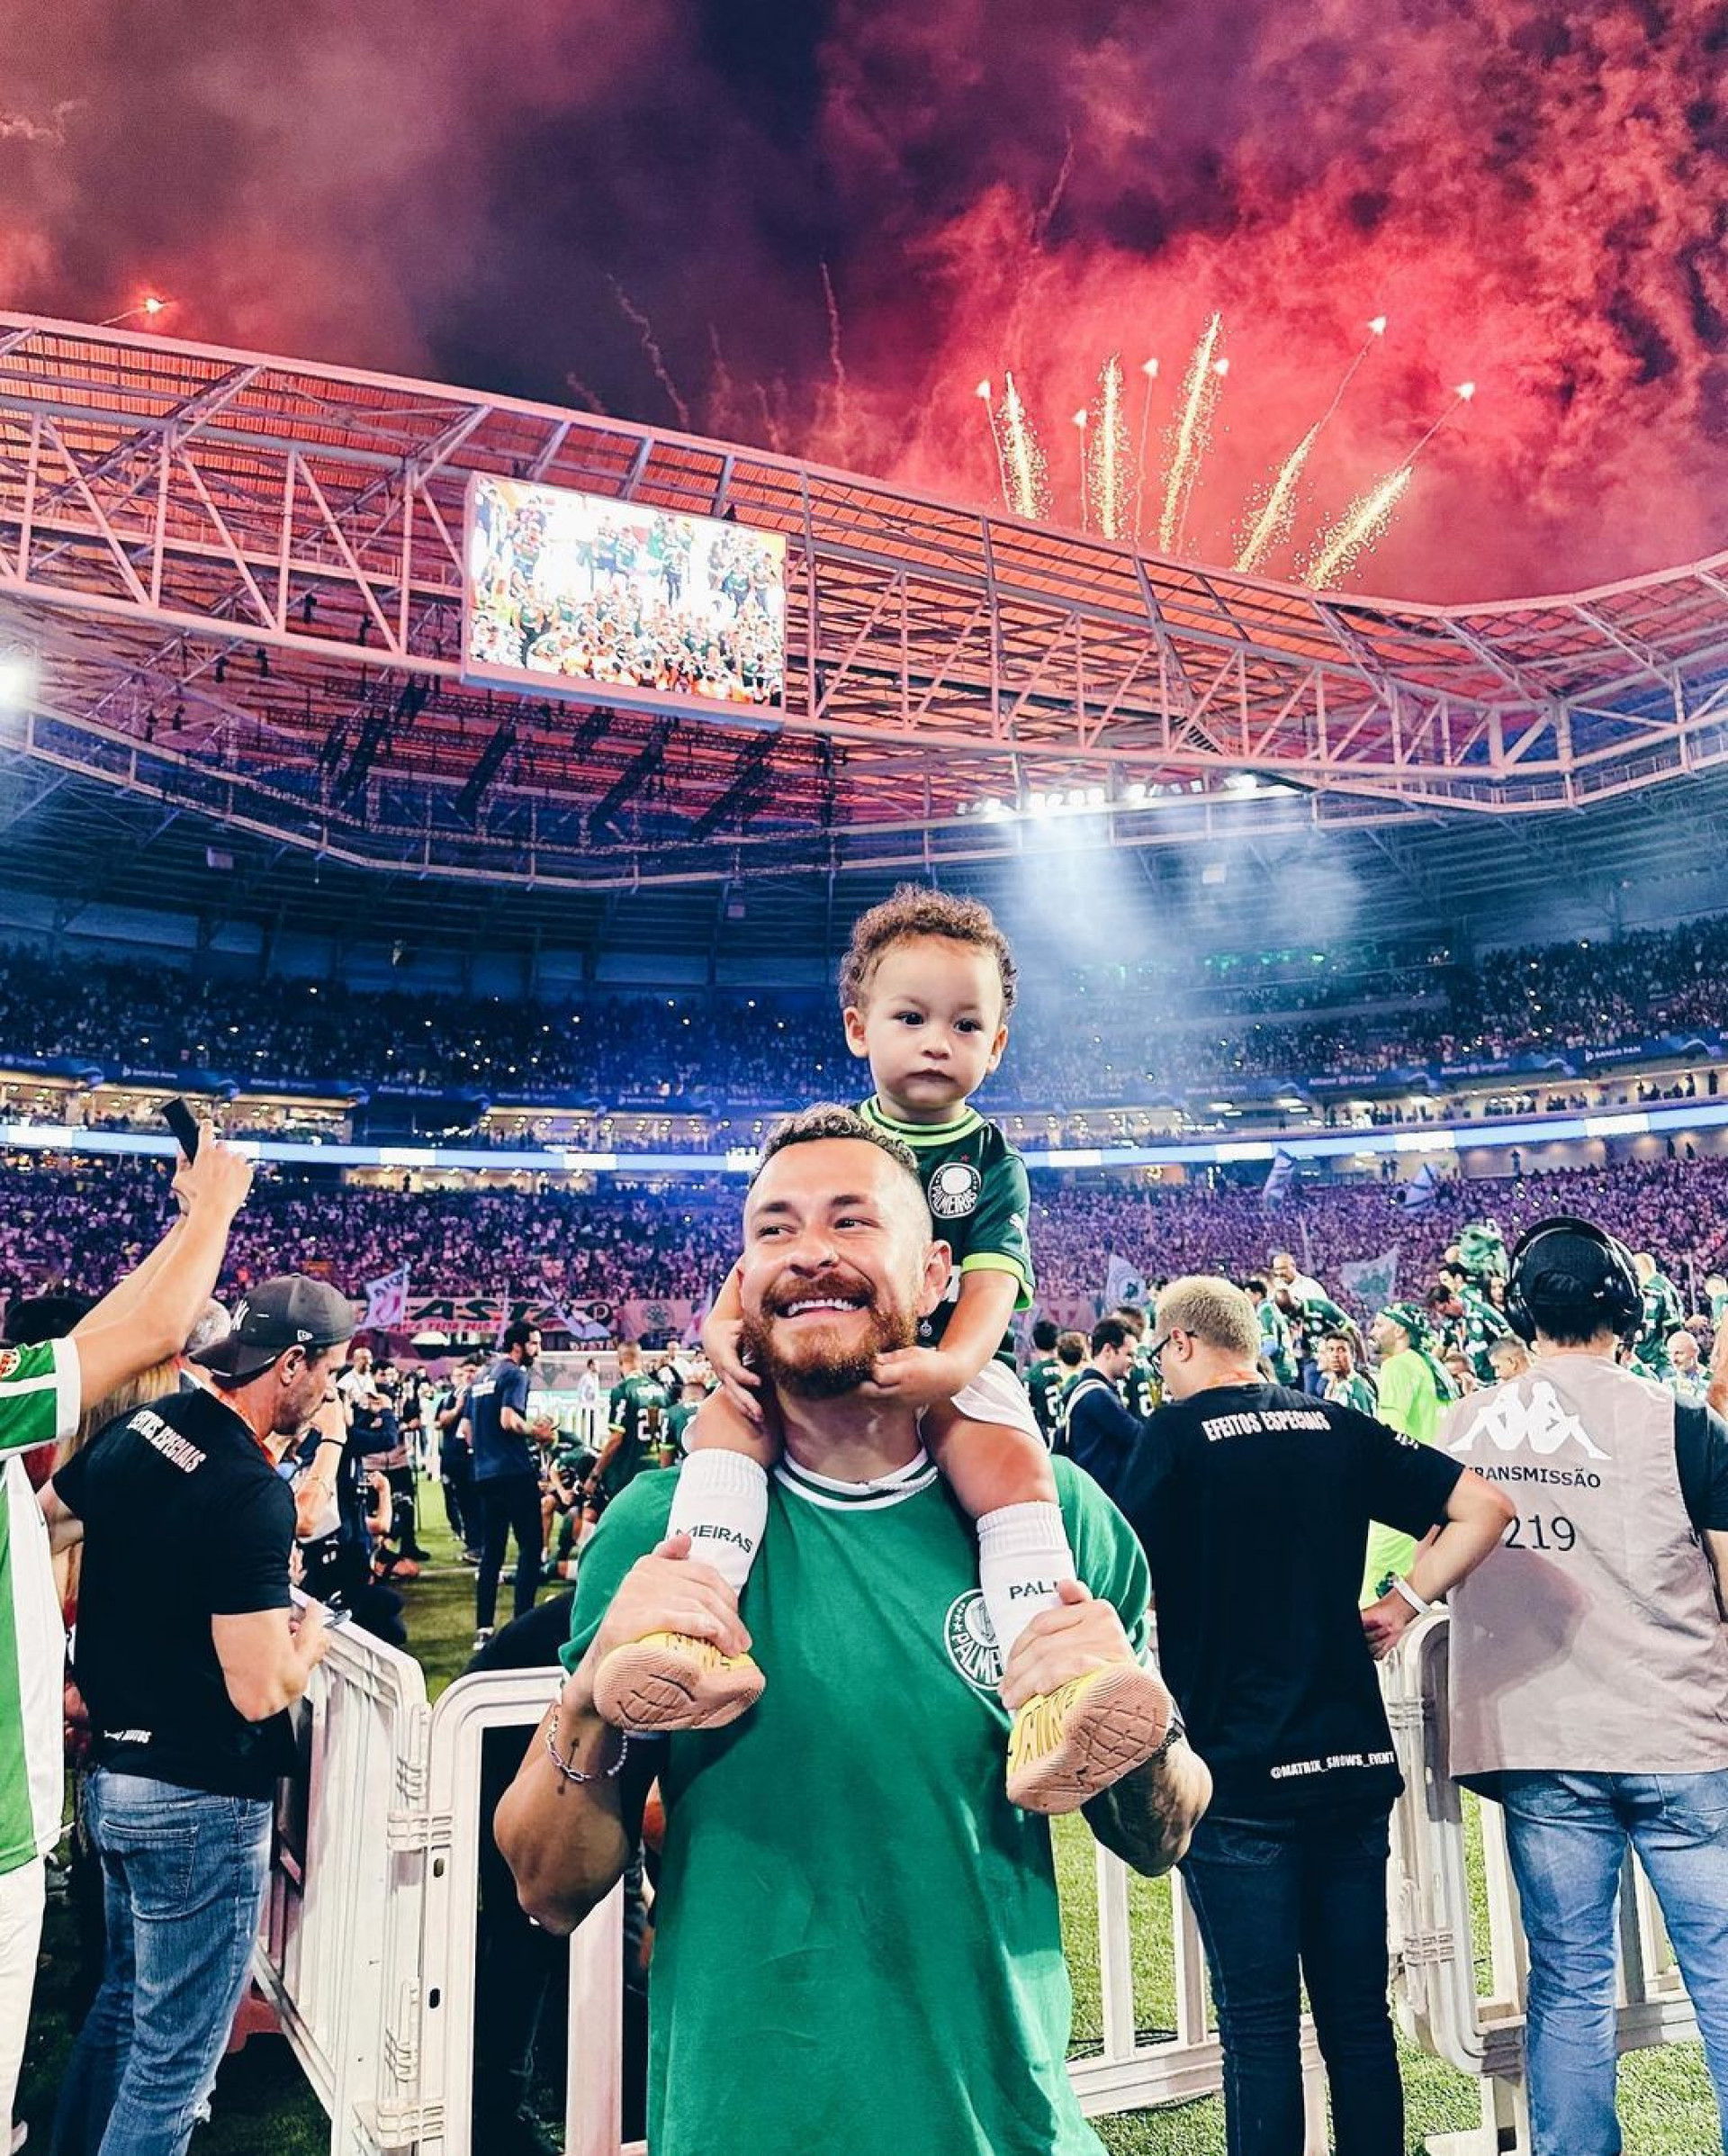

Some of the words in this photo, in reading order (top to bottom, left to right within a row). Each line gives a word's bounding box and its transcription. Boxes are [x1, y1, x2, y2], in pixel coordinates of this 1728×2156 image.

[1202, 1413, 1263, 1441] EFEITOS
[1260, 1411, 1331, 1431] ESPECIAIS
[1505, 1514, 1576, 1551] 219
[1010, 1581, 1058, 1600] PAL
